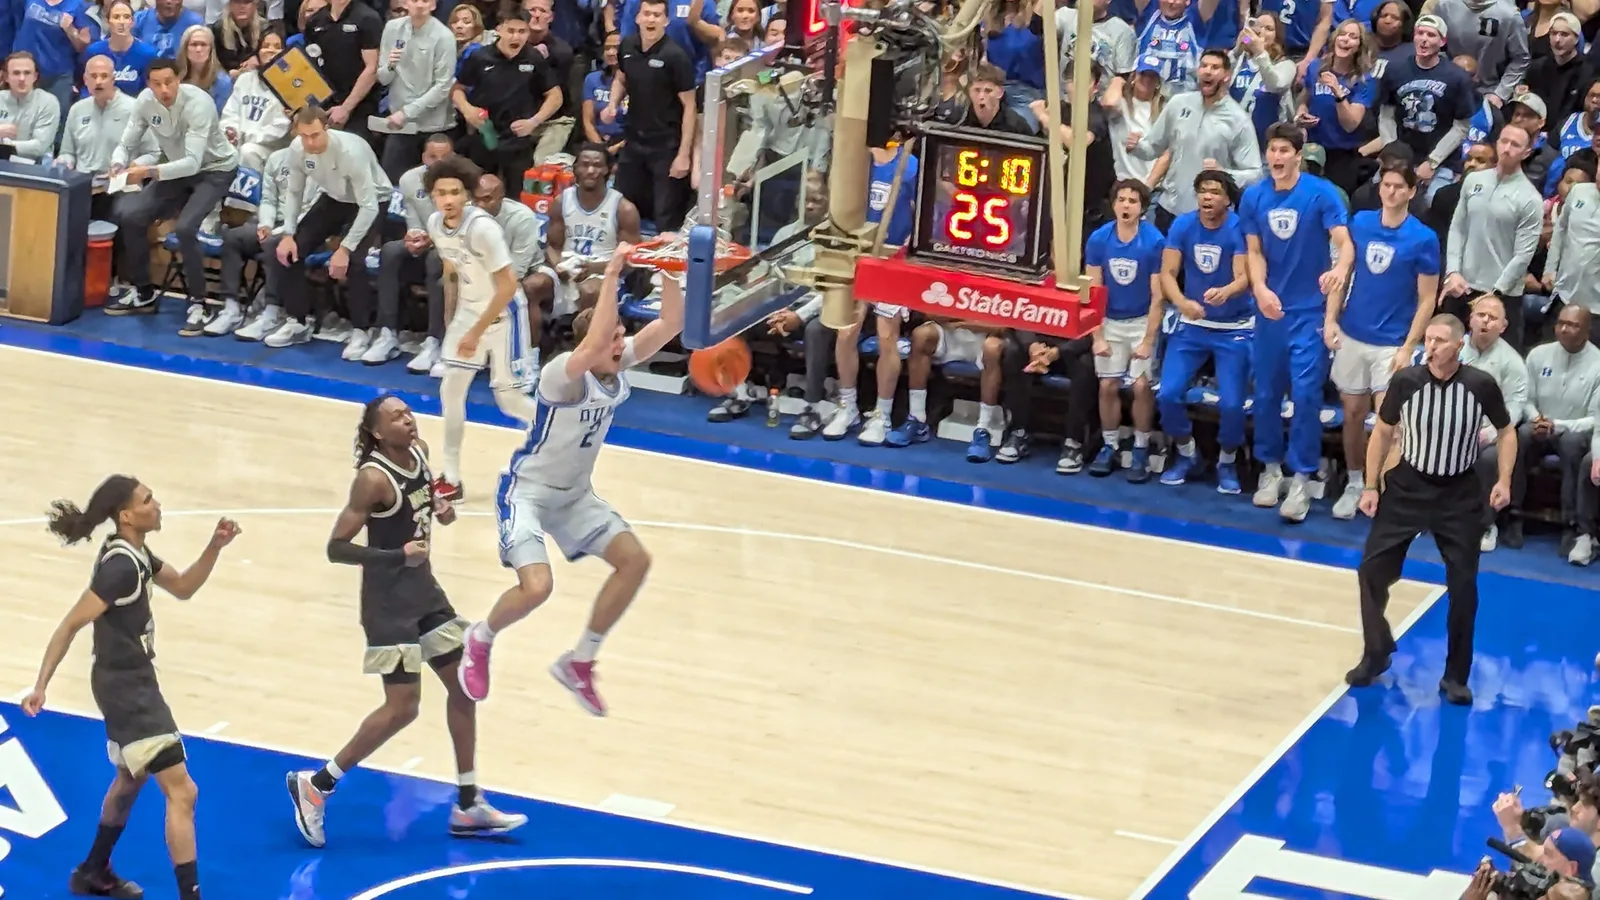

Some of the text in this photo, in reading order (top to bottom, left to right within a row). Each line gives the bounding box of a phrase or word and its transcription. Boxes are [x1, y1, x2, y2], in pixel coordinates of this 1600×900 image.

[1279, 0, 1296, 24] 2
[1478, 16, 1499, 37] D
[957, 150, 1032, 194] 6:10
[950, 193, 1009, 244] 25
[564, 224, 608, 241] DUKE
[579, 419, 602, 448] 2
